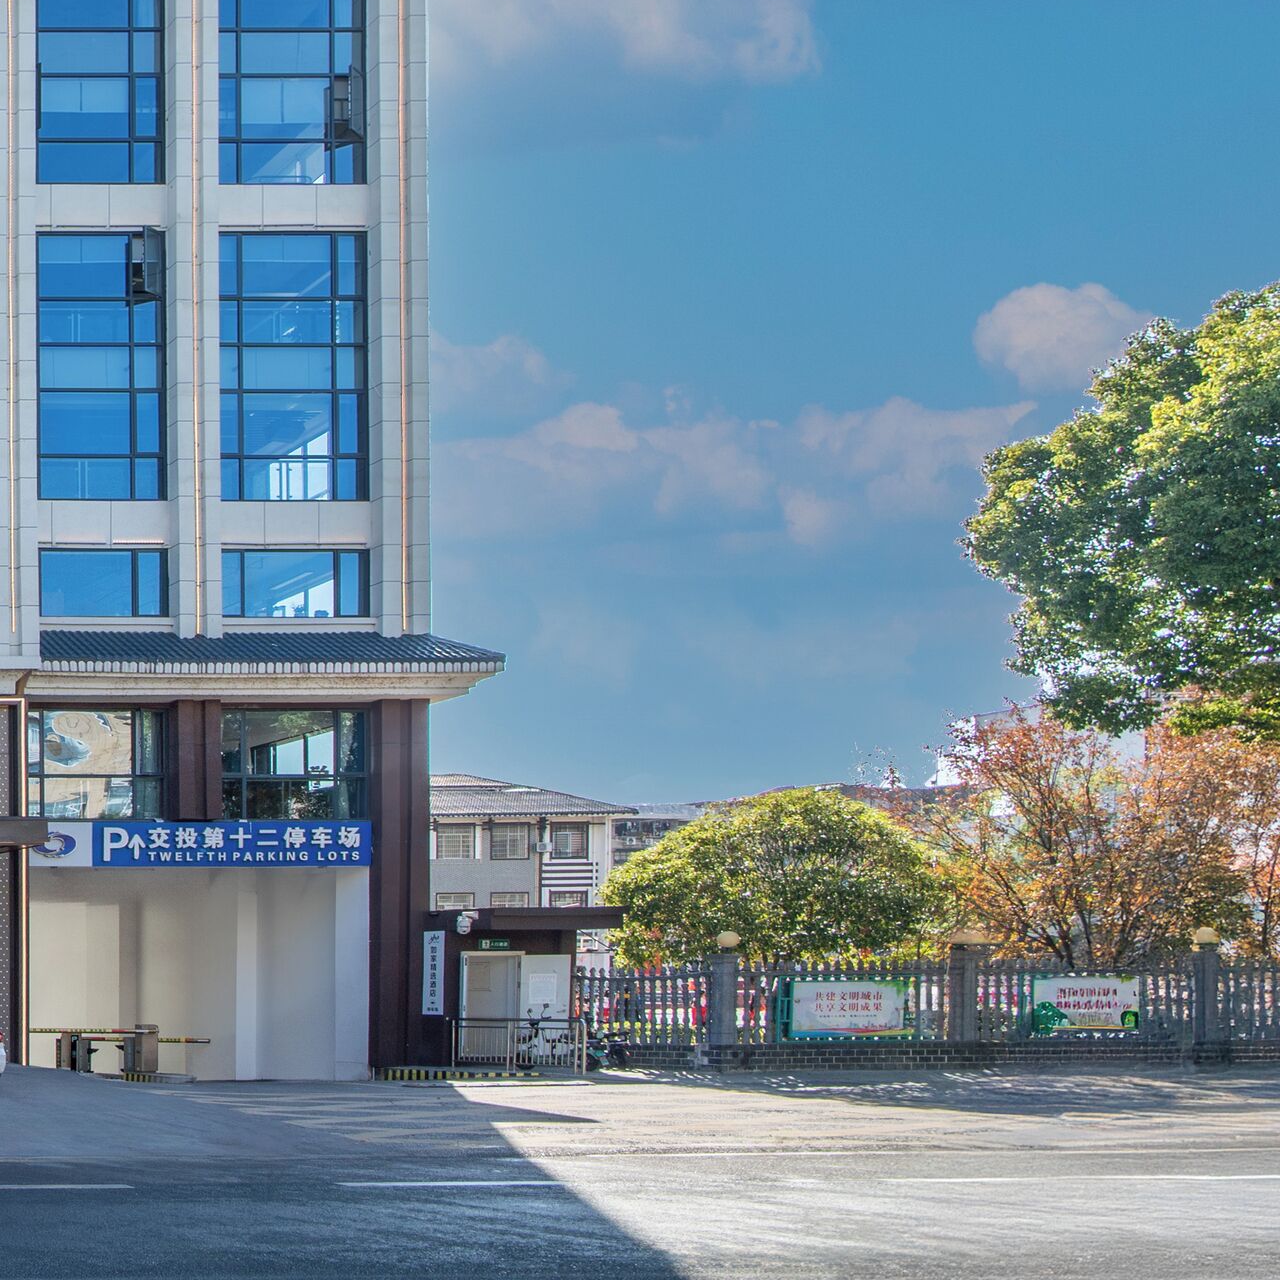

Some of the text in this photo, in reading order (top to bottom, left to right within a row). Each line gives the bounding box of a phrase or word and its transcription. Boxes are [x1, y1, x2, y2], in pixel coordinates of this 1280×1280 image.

[102, 826, 129, 862] P
[148, 826, 361, 849] 交投第十二停车场
[148, 850, 360, 862] TWELFTH PARKING LOTS
[429, 946, 437, 998] 如家精选酒店
[815, 991, 883, 1001] 共建文明城市
